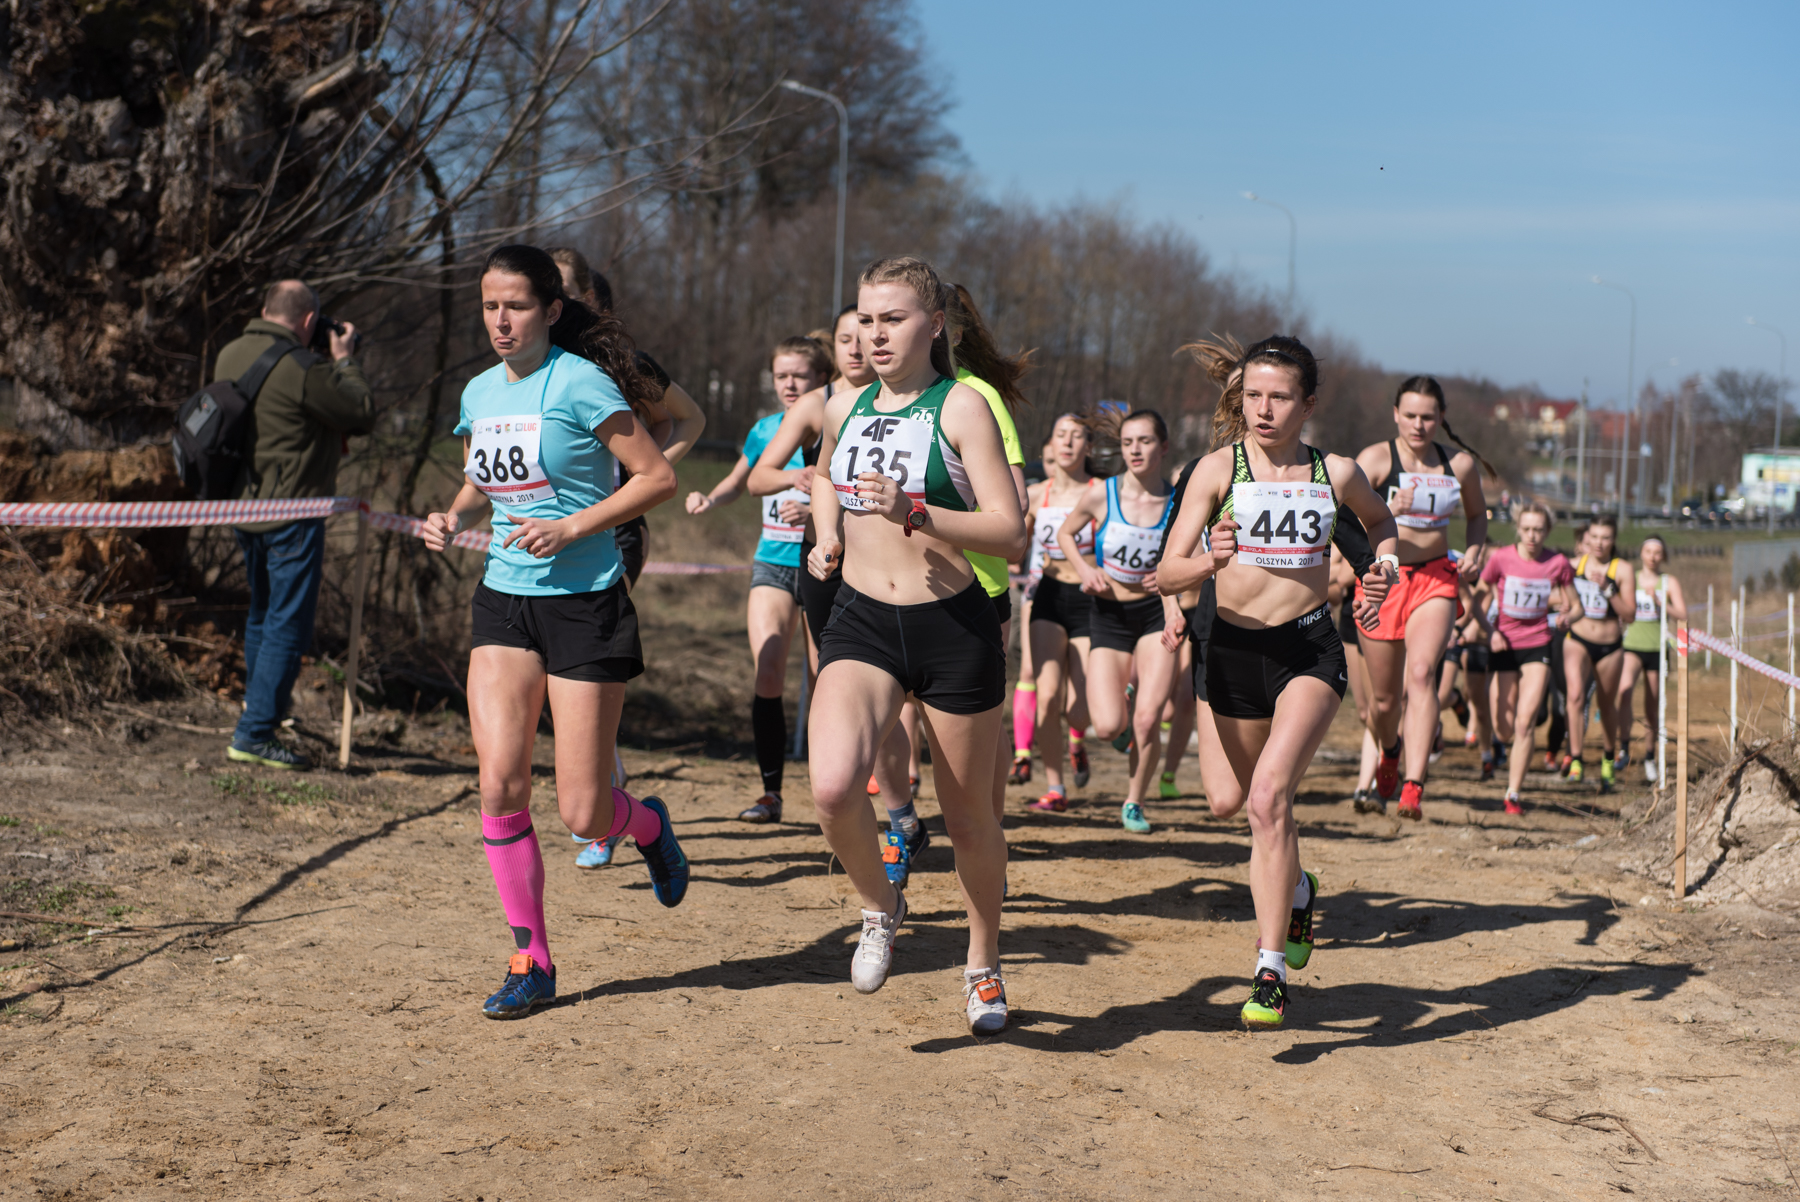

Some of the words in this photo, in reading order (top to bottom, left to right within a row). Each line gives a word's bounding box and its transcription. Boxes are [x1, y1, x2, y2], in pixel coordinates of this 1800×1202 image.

[523, 422, 537, 432] LUG
[861, 417, 902, 443] 4F
[473, 445, 530, 484] 368
[846, 445, 912, 487] 135
[516, 492, 535, 503] 2019
[1317, 490, 1330, 499] LUG
[1249, 509, 1322, 545] 443
[1112, 544, 1159, 569] 463
[1255, 556, 1294, 566] OLSZYNA
[1298, 557, 1315, 566] 2019
[1513, 591, 1542, 608] 171
[1297, 608, 1323, 629] NIKE
